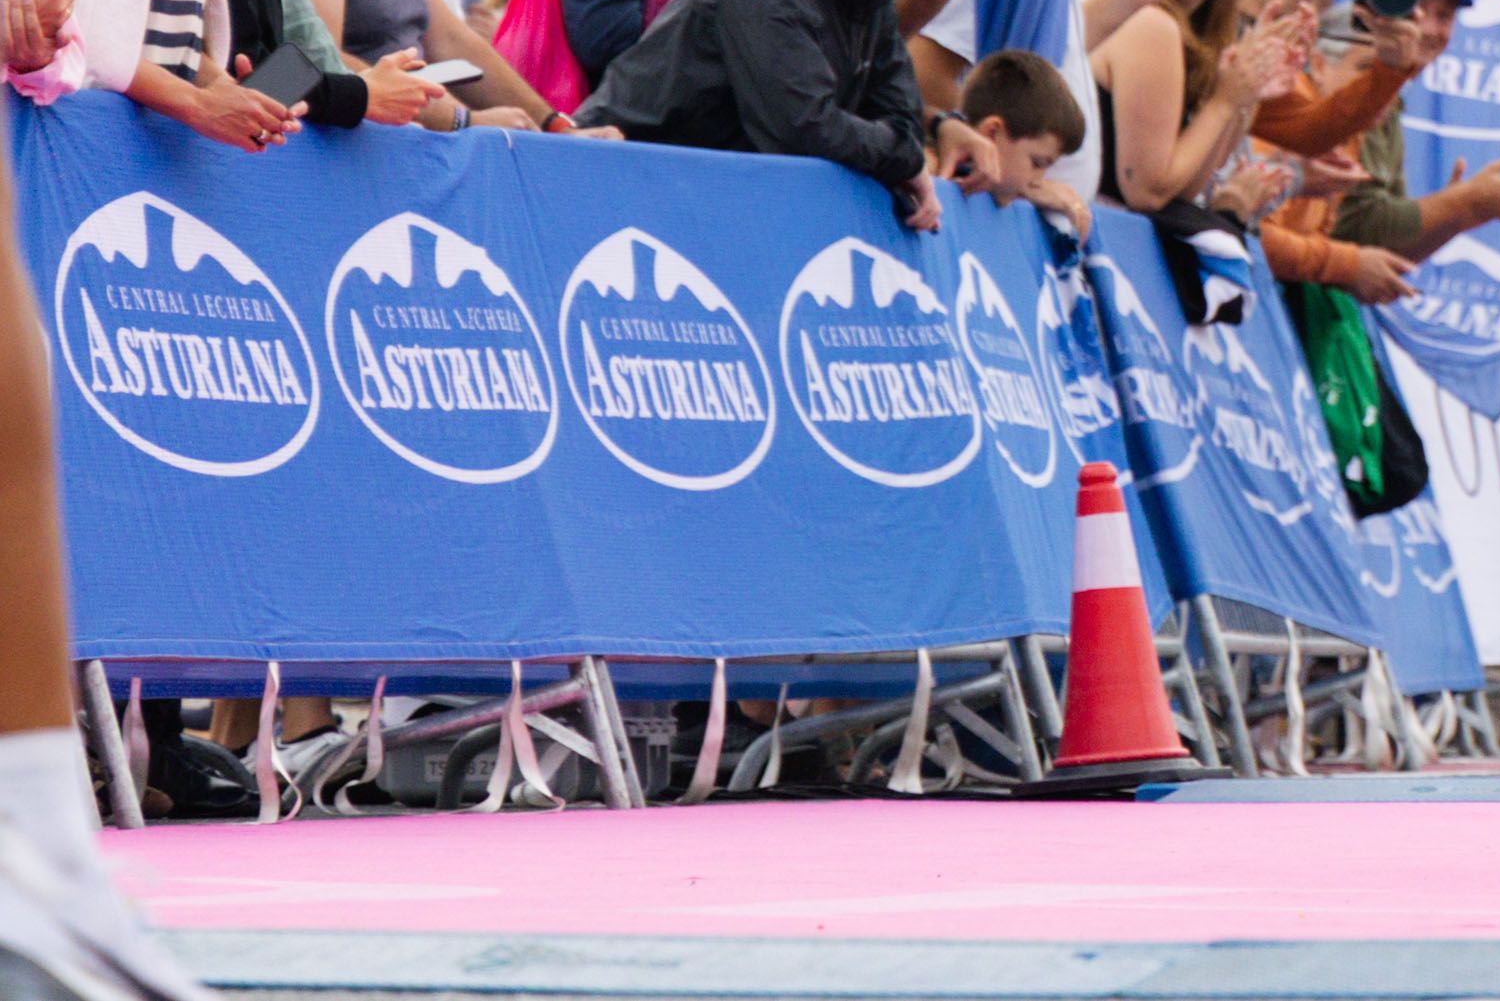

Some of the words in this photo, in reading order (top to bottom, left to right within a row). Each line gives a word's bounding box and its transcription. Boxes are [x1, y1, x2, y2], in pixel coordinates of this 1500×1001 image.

[106, 284, 190, 315] CENTRAL
[193, 293, 276, 323] LECHERA
[372, 305, 451, 330] CENTRAL
[79, 286, 308, 406] ASTURIANA
[601, 317, 669, 342] CENTRAL
[670, 320, 738, 346] LECHERA
[818, 324, 888, 348] CENTRAL
[350, 308, 549, 412] ASTURIANA
[580, 319, 766, 422] ASTURIANA
